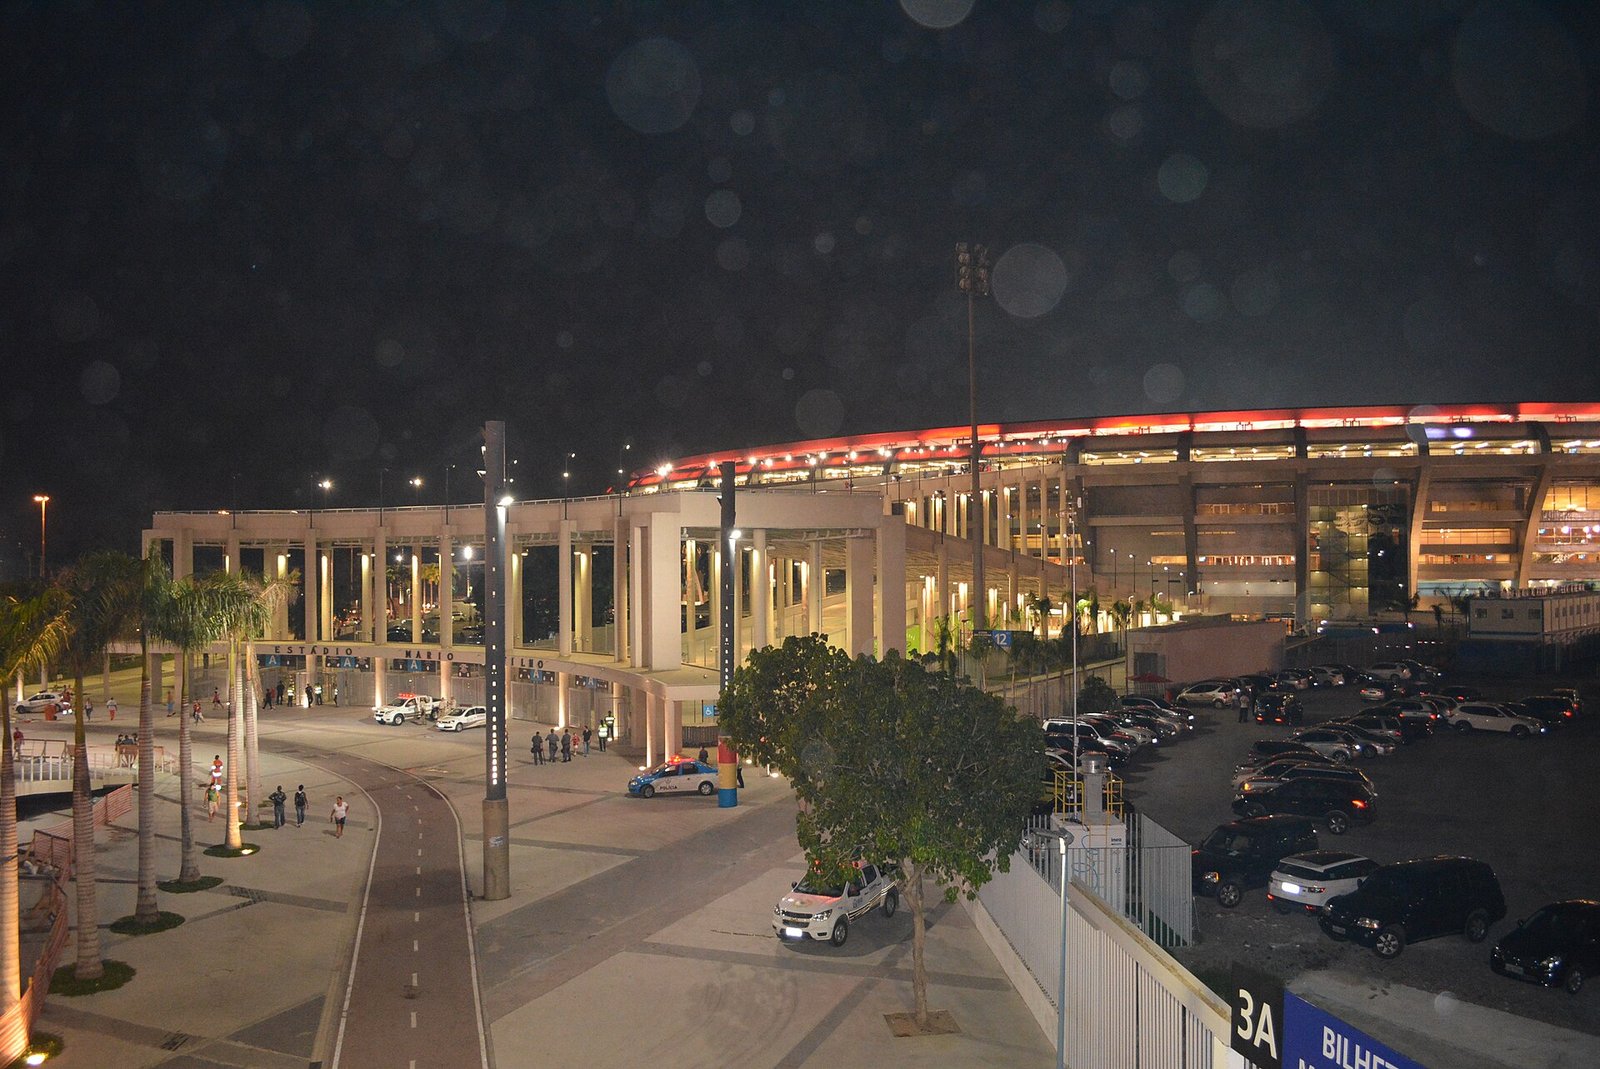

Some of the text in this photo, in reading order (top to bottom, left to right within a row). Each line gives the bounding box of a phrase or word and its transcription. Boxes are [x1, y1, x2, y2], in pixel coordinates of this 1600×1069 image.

[995, 633, 1007, 645] 12
[268, 655, 277, 665] A
[343, 657, 352, 667] A
[411, 660, 418, 670] A
[505, 657, 544, 669] ILHO
[1237, 988, 1277, 1060] 3A
[1322, 1025, 1399, 1069] BILH
